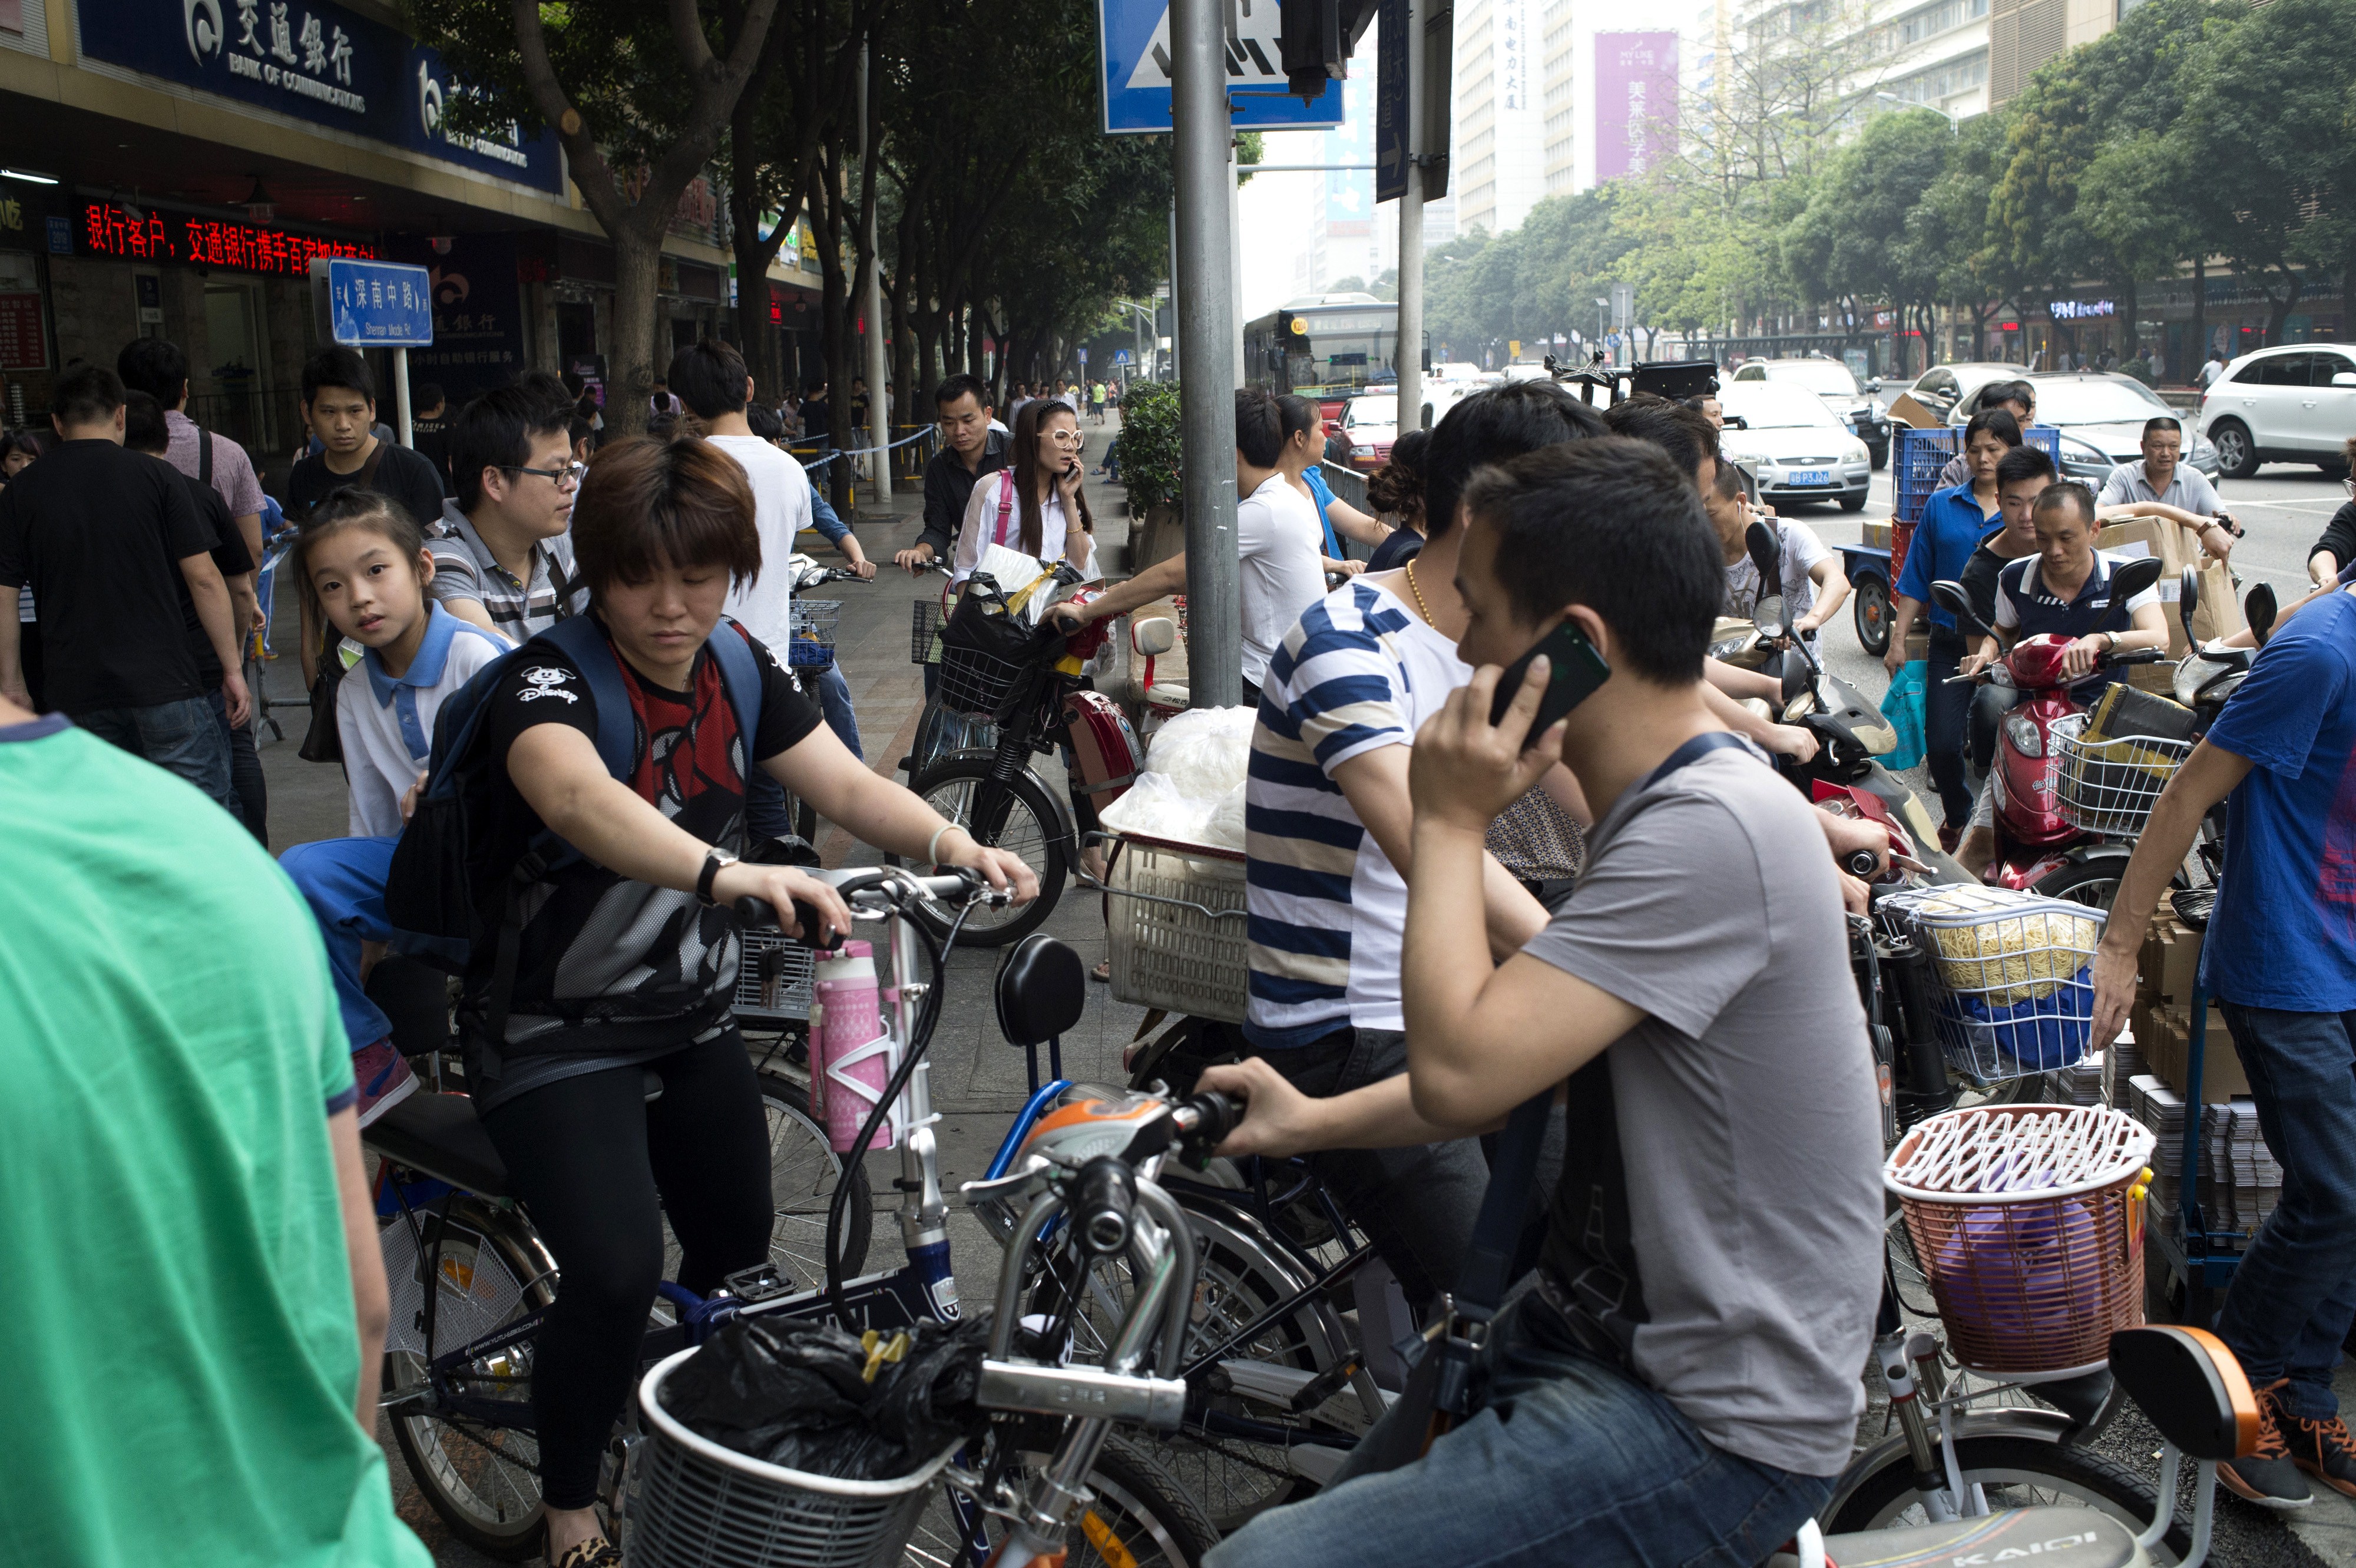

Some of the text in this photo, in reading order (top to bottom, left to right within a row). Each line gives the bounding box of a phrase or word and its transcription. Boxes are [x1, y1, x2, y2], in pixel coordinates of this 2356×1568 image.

[229, 52, 366, 114] BANK OF COMMUNICATIONS
[355, 279, 412, 310] 深南中路
[1953, 1531, 2097, 1568] KAIQI
